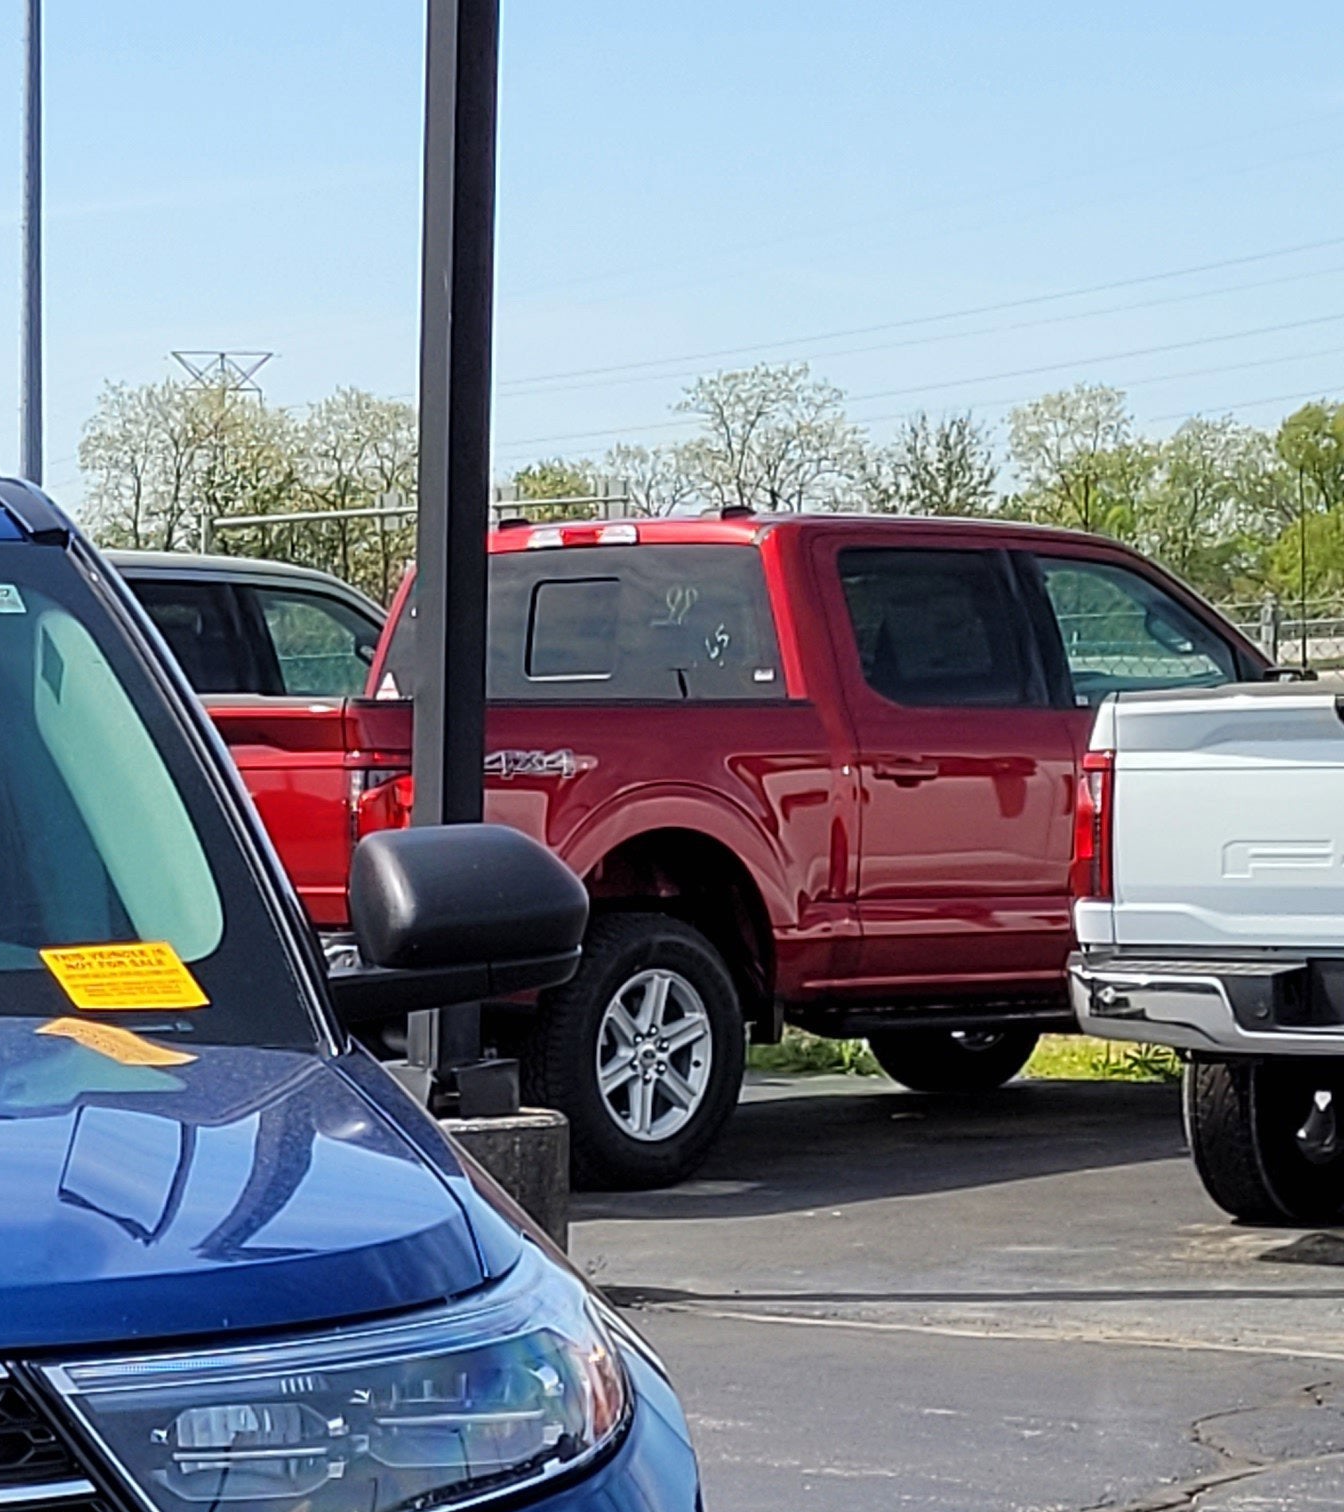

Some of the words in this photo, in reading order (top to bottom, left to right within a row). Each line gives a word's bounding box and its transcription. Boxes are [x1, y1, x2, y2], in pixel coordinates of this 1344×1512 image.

[65, 961, 92, 970] NOT
[98, 959, 126, 969] FOR
[129, 958, 167, 968] SALE
